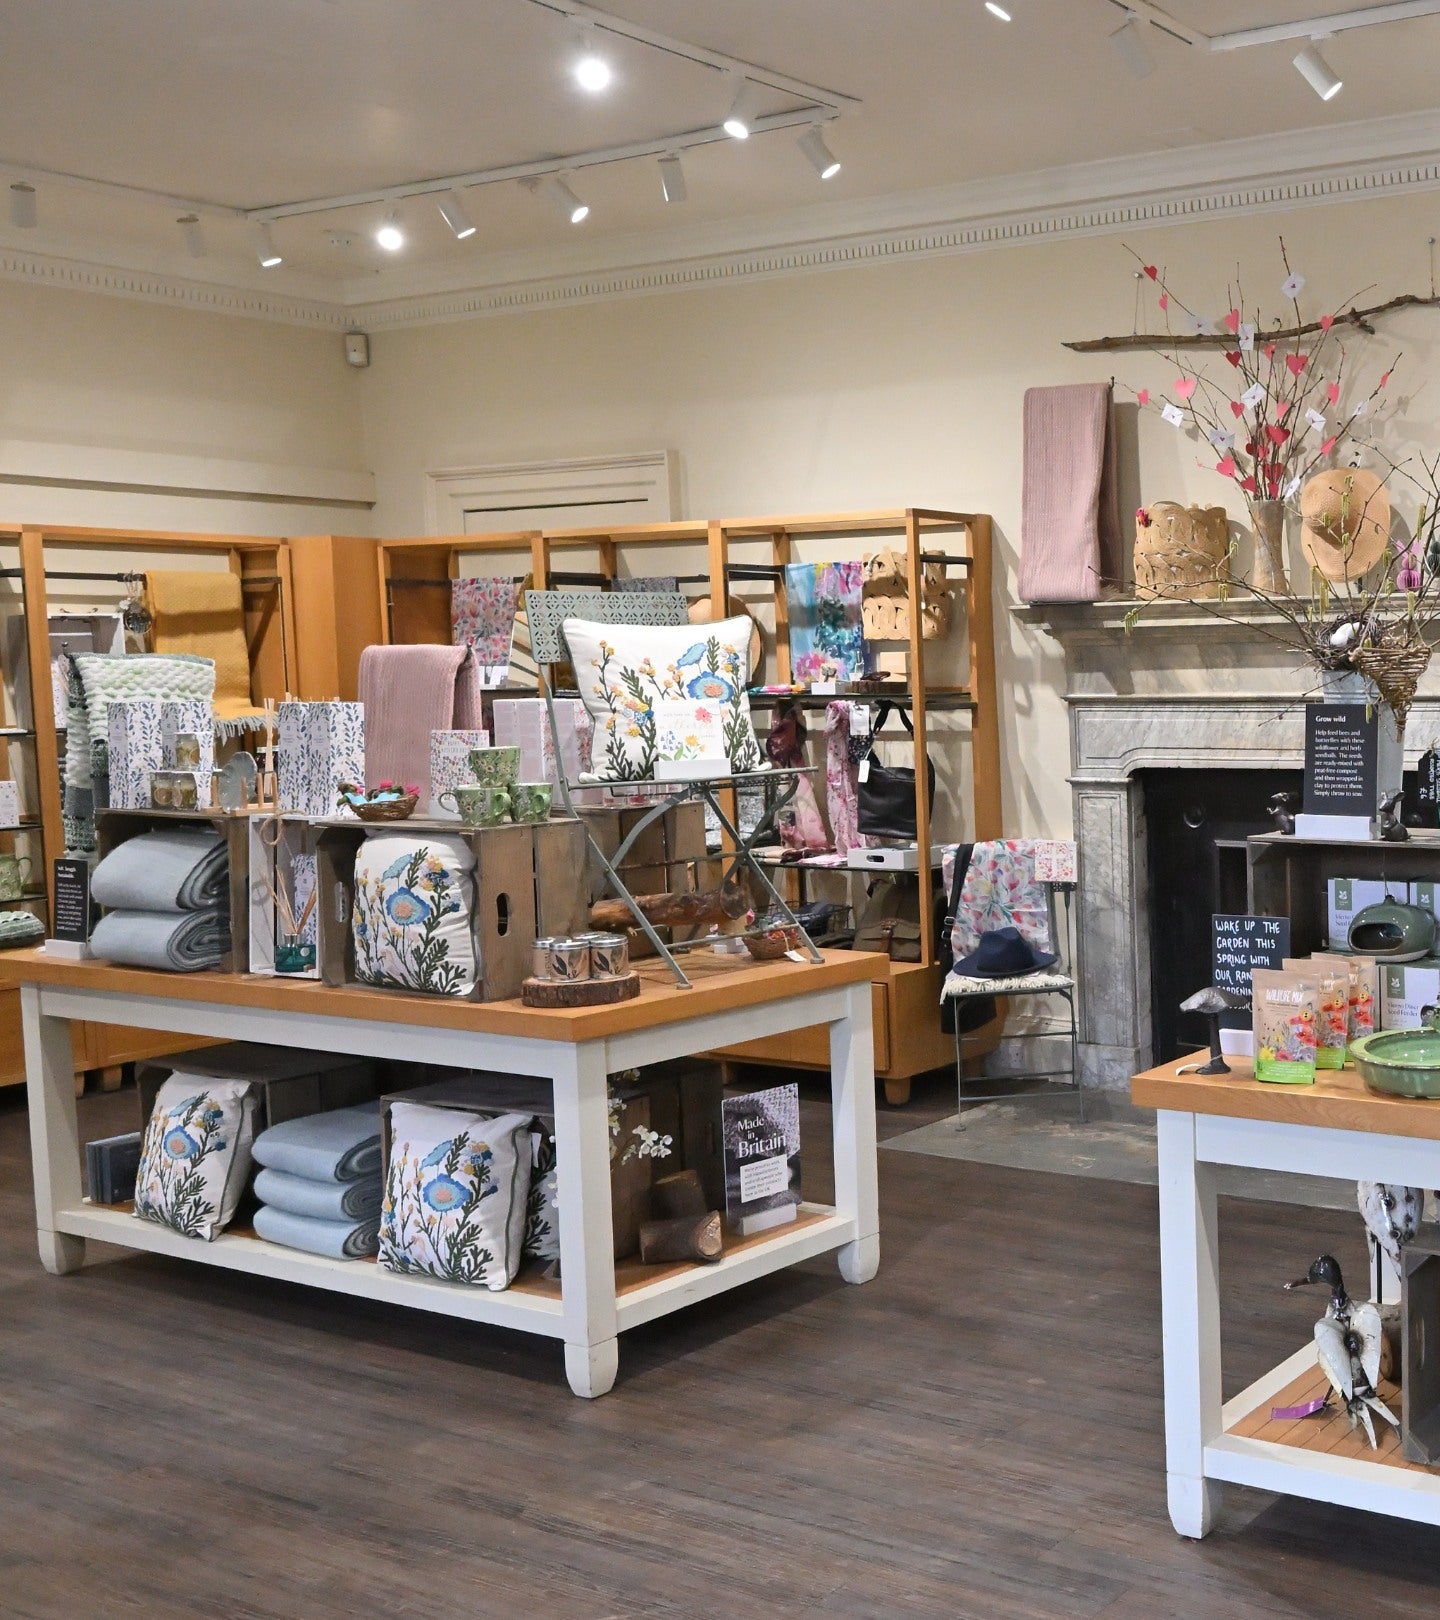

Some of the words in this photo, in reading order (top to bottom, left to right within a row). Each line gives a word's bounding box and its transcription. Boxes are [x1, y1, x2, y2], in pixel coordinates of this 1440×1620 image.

[1315, 715, 1332, 723] Grow
[1333, 715, 1346, 723] wild
[1215, 920, 1240, 934] WAKE
[1244, 920, 1256, 931] UP
[1262, 921, 1281, 934] THE
[1216, 936, 1250, 951] GARDEN
[1255, 938, 1276, 949] THIS
[1216, 953, 1247, 967] SPRING
[1250, 955, 1270, 966] WITH
[1215, 969, 1234, 985] OUR
[1235, 970, 1253, 983] RAN
[1292, 991, 1304, 1003] MIX
[737, 1116, 765, 1131] Made
[747, 1130, 755, 1139] in
[739, 1133, 786, 1158] Britain
